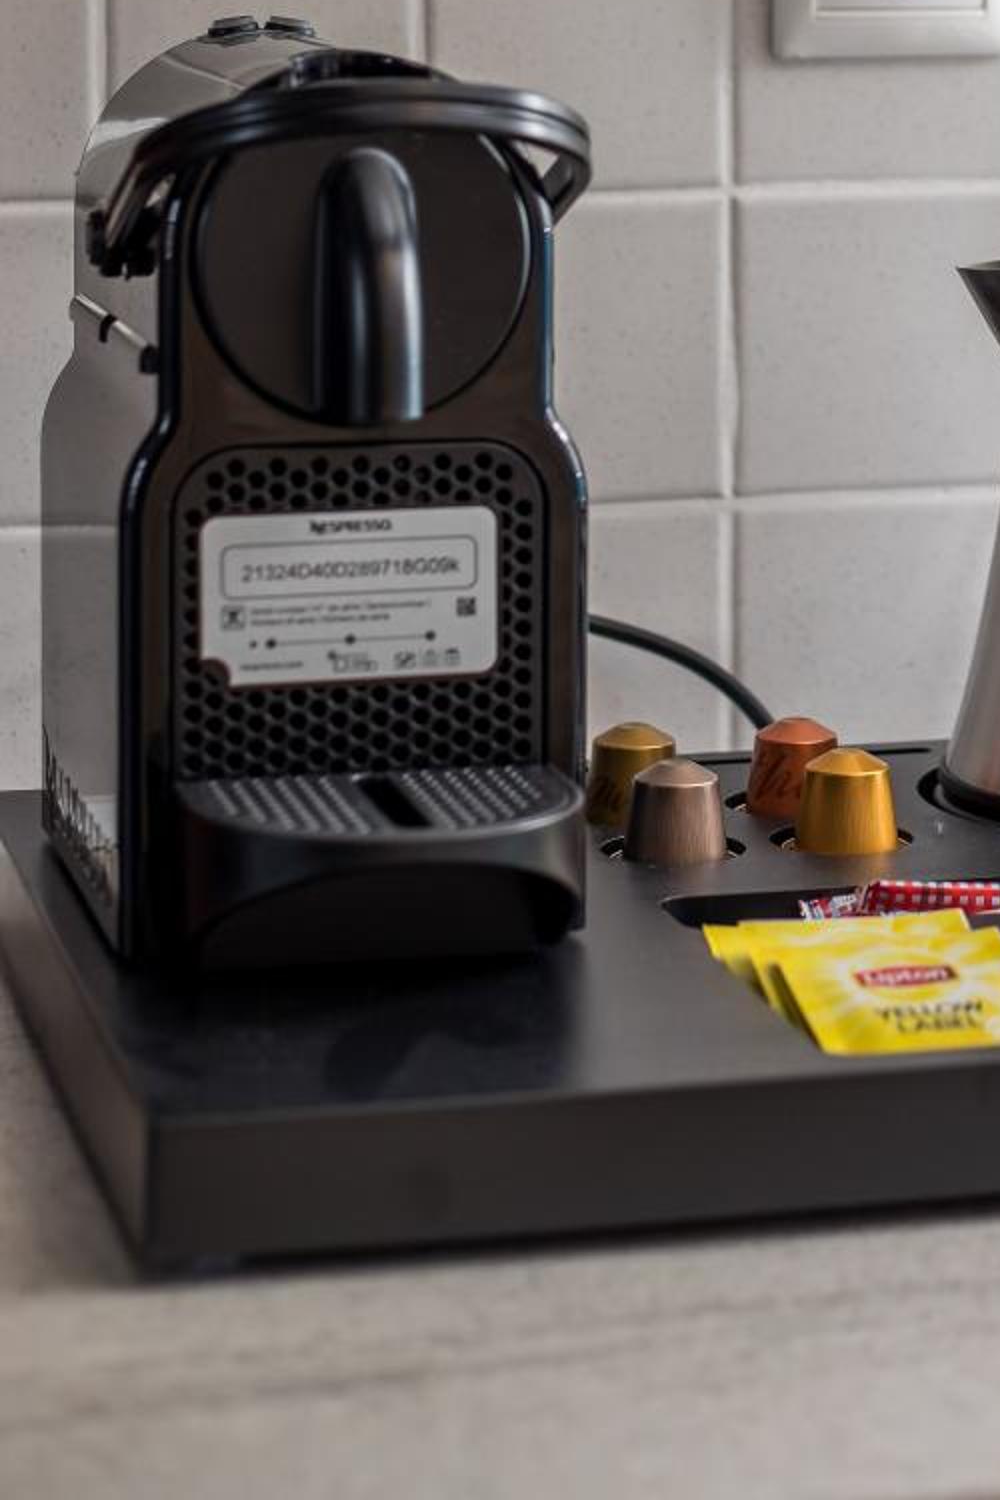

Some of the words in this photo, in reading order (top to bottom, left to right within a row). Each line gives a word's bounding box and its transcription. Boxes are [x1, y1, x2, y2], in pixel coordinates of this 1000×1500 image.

[862, 967, 950, 987] Lipton
[876, 999, 983, 1021] YELLOW
[897, 1015, 979, 1034] LABEL
